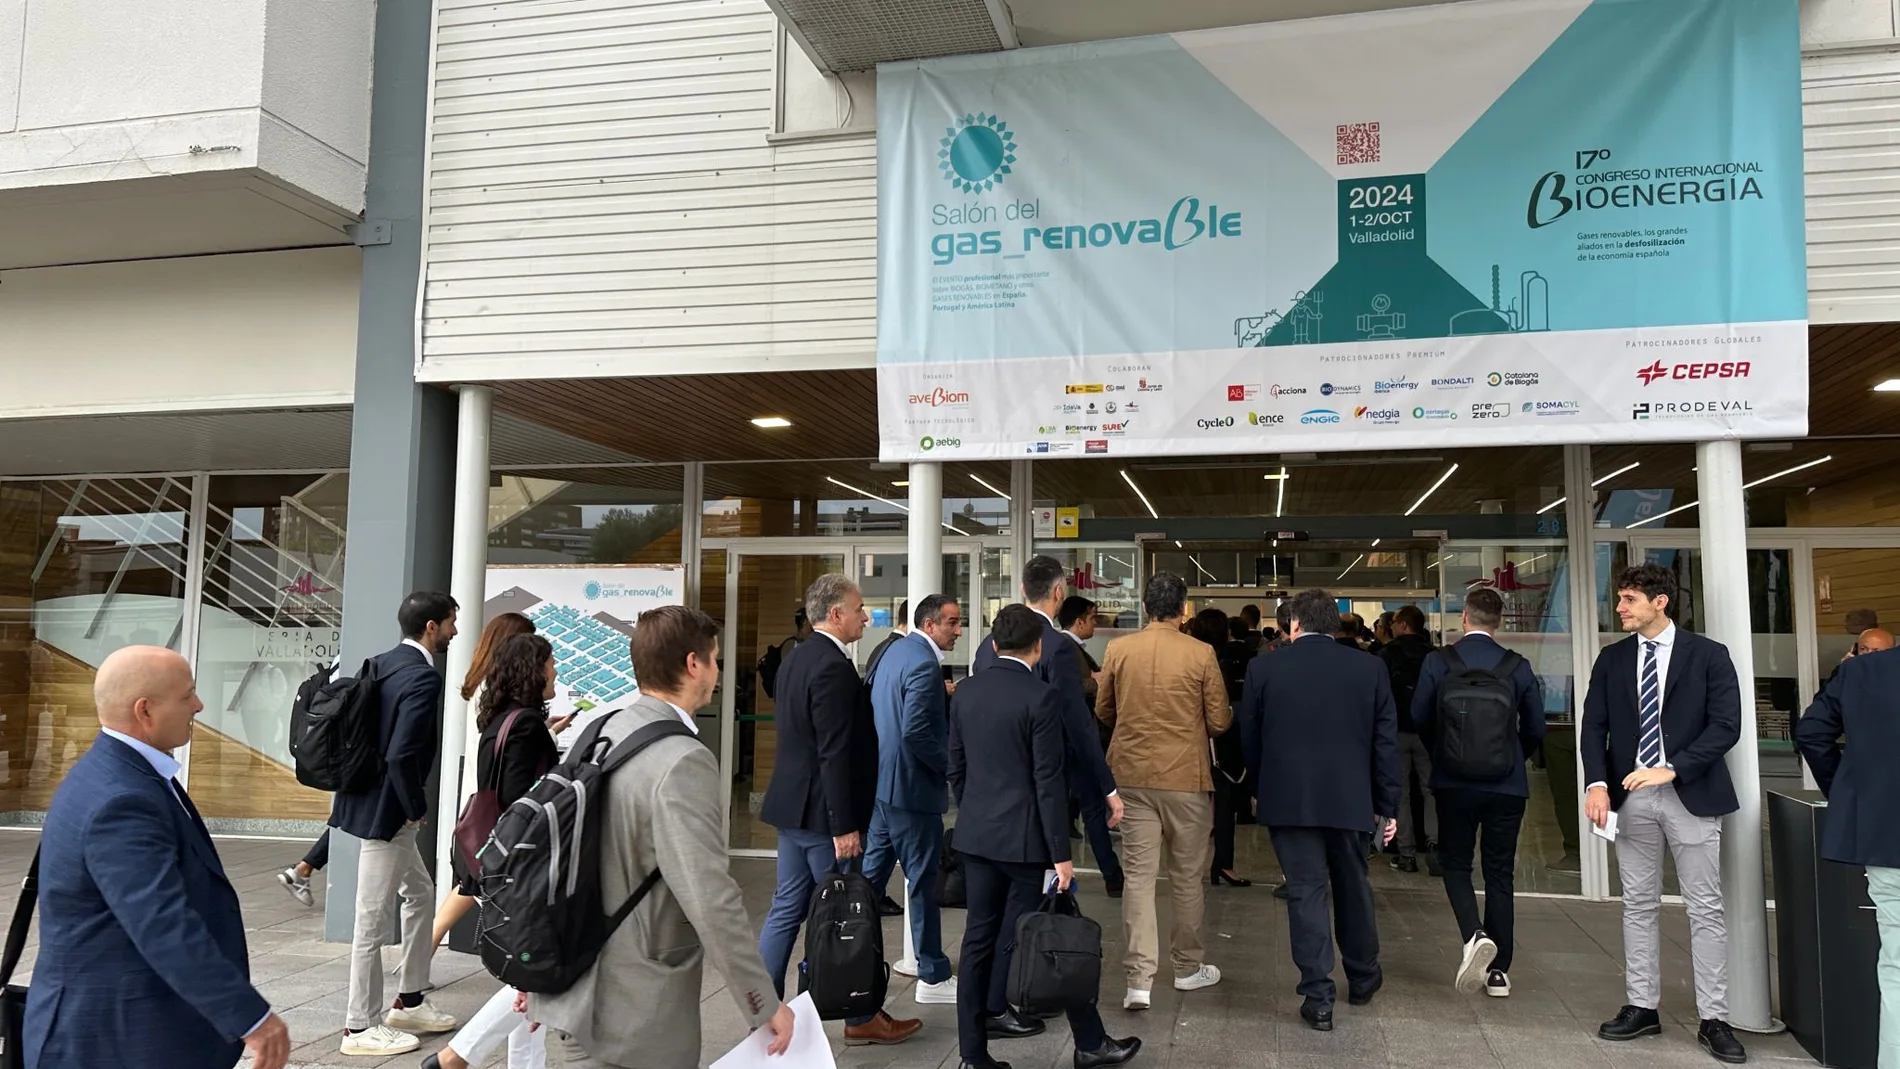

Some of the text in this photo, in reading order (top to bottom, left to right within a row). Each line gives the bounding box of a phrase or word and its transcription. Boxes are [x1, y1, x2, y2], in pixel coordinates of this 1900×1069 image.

[1575, 161, 1763, 186] CONGRESO INTERNACIONAL
[1349, 184, 1414, 209] 2024
[1527, 171, 1764, 229] BIOENERGÍA
[932, 198, 1040, 225] Salón del
[1349, 211, 1413, 227] 1-2/OCT
[1349, 228, 1415, 244] Valladolid
[1577, 226, 1688, 240] Gases renovables, los grandes
[1577, 242, 1603, 251] aliados
[1624, 238, 1685, 248] desfosilización
[1577, 249, 1670, 262] de la economía española
[963, 273, 1001, 283] profesional
[1016, 271, 1050, 280] importante
[932, 285, 949, 293] sobre
[975, 282, 1013, 290] BIOMETANO
[953, 292, 992, 300] RENOVABLES
[932, 303, 961, 312] Portugal
[966, 301, 993, 309] América
[1672, 361, 1751, 380] CEPSA
[1374, 381, 1419, 390] Bioenergy
[1431, 377, 1474, 386] BONDALTI
[1278, 386, 1307, 395] acciona
[1536, 401, 1580, 409] SOMACYL
[1655, 400, 1753, 413] PRODEVAL
[1259, 414, 1284, 424] ence
[1366, 409, 1400, 421] nedgia
[936, 437, 961, 448] aebig
